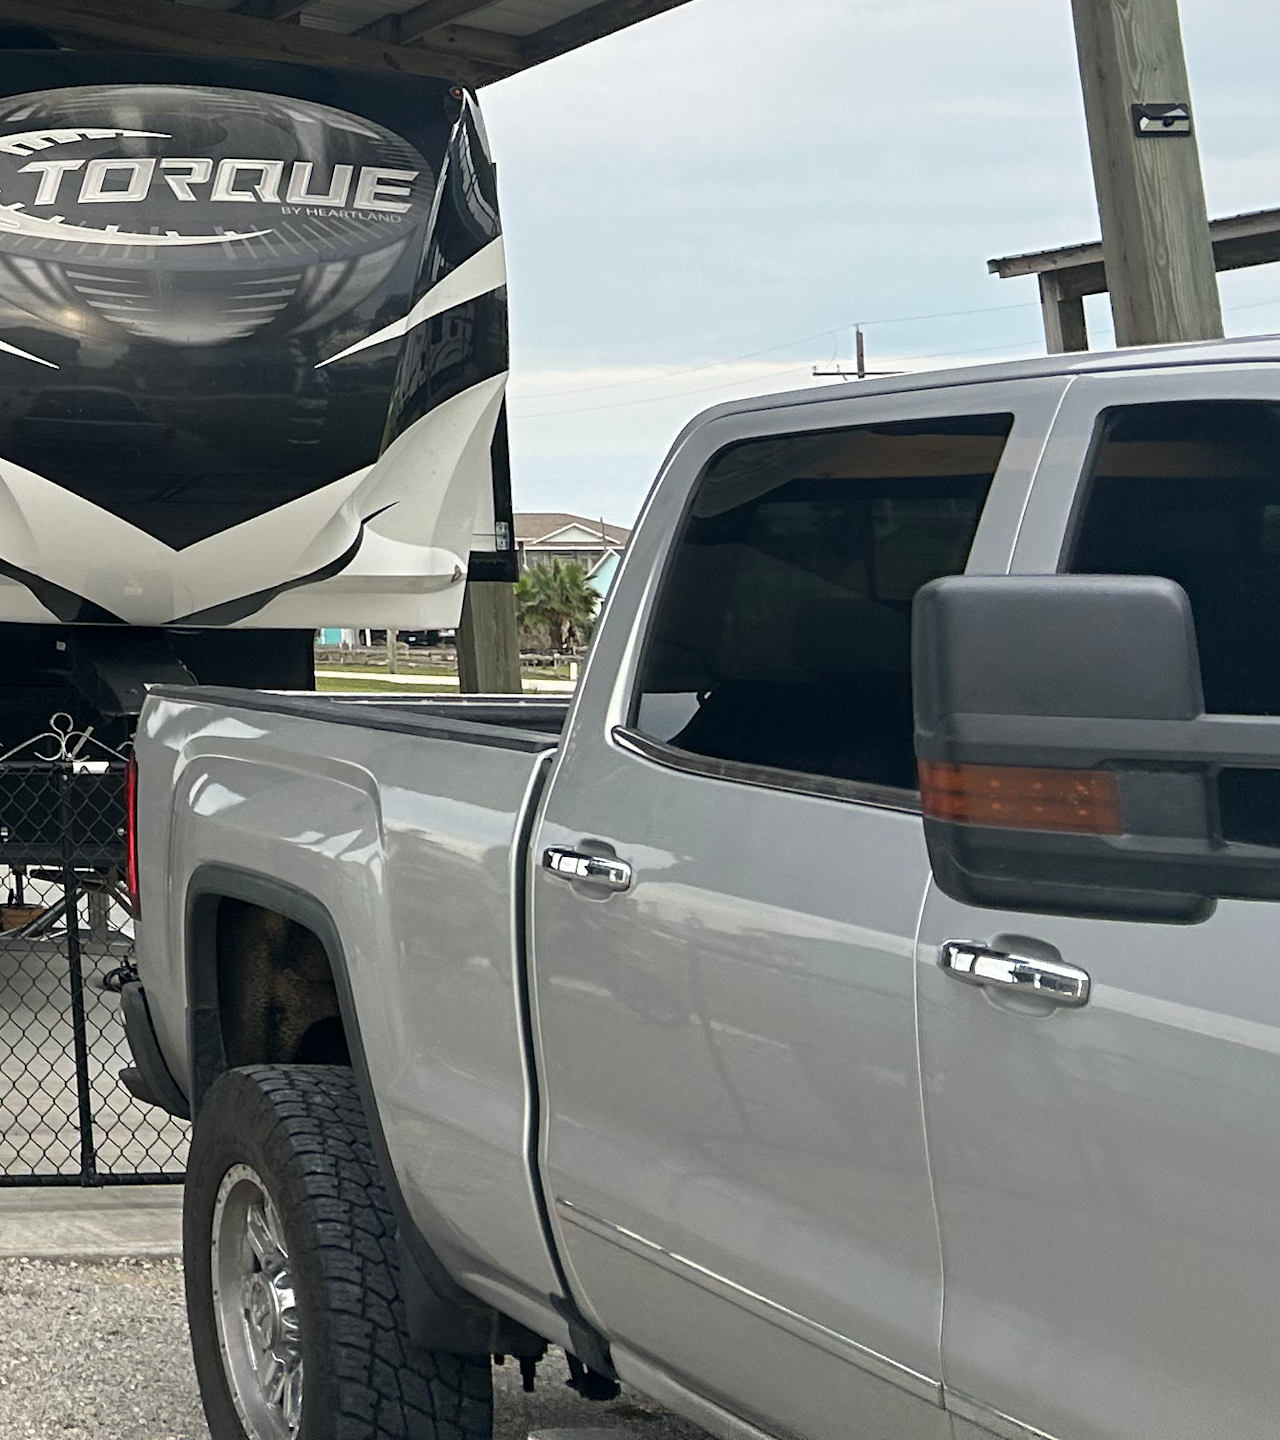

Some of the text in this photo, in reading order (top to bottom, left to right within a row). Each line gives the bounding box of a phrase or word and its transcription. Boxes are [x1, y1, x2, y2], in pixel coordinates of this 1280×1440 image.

[17, 157, 420, 213] TORQUE
[282, 206, 402, 223] BY HEARTLAND
